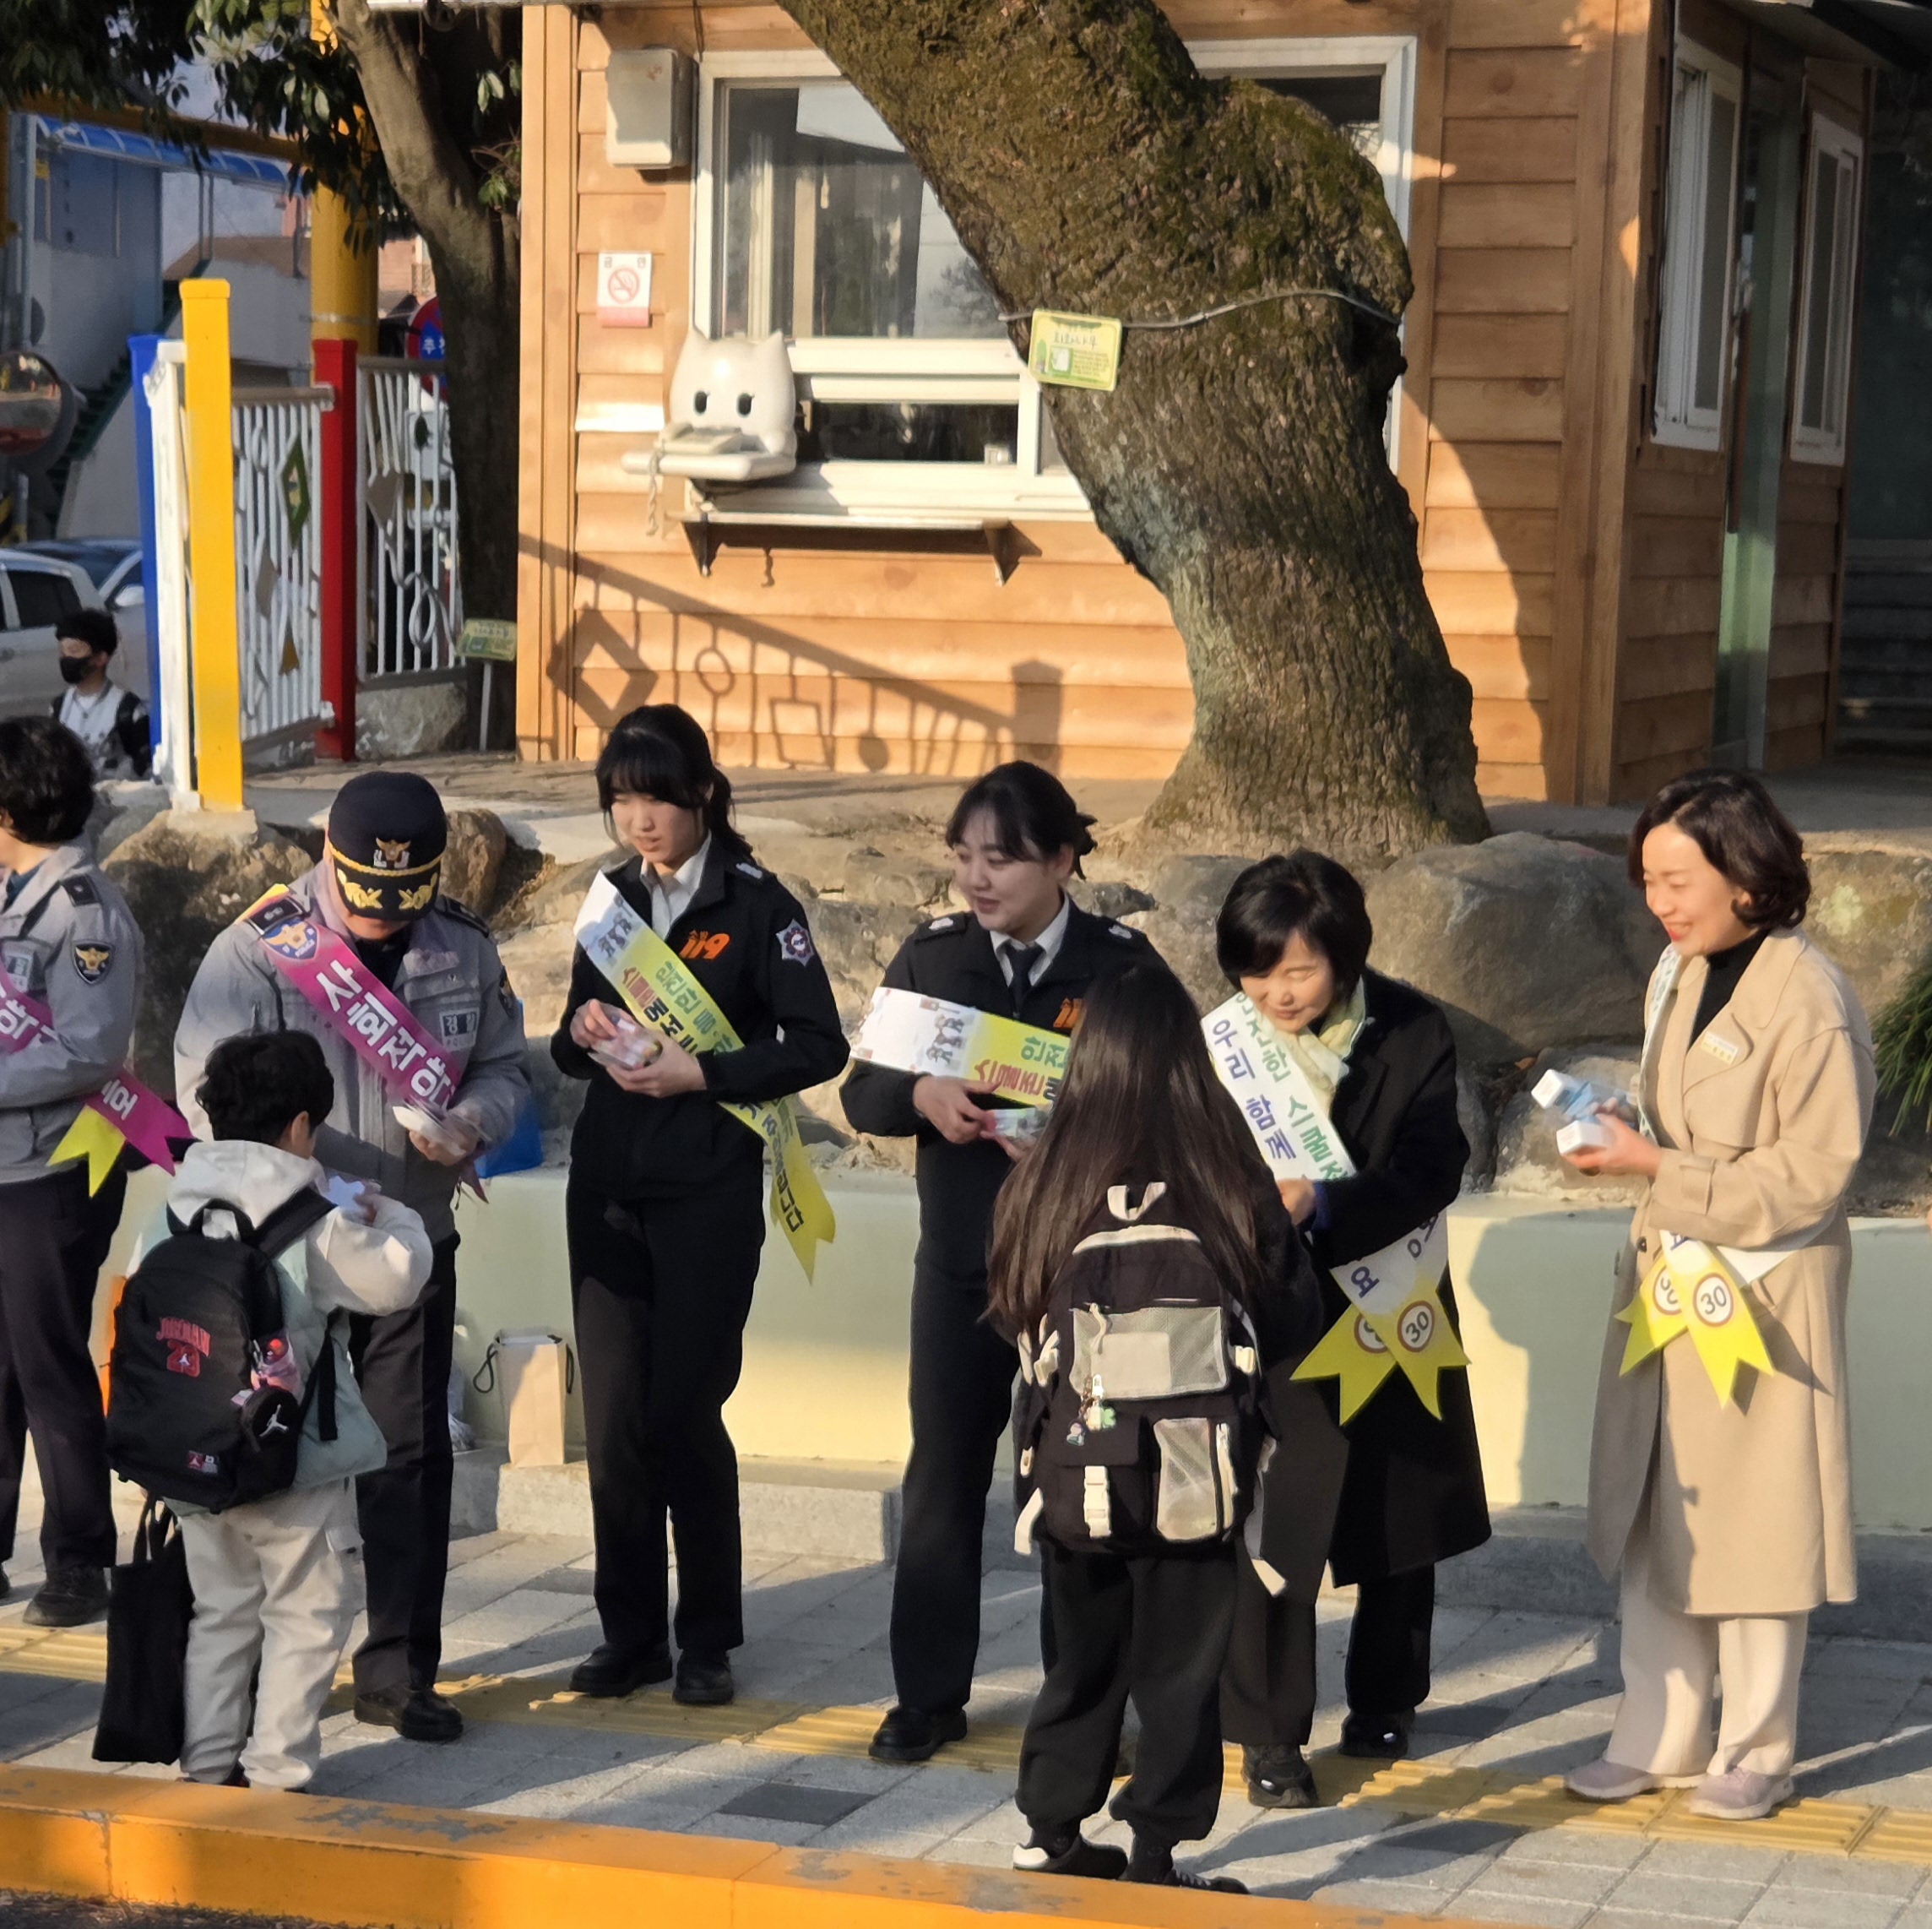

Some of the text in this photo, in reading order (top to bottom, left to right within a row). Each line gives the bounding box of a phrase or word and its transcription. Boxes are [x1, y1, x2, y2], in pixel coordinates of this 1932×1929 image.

[679, 932, 732, 960] 119
[316, 959, 456, 1111] 사회적약
[1212, 1019, 1297, 1160] 우리 함께
[1700, 1285, 1727, 1316] 30
[1405, 1311, 1430, 1343] 30
